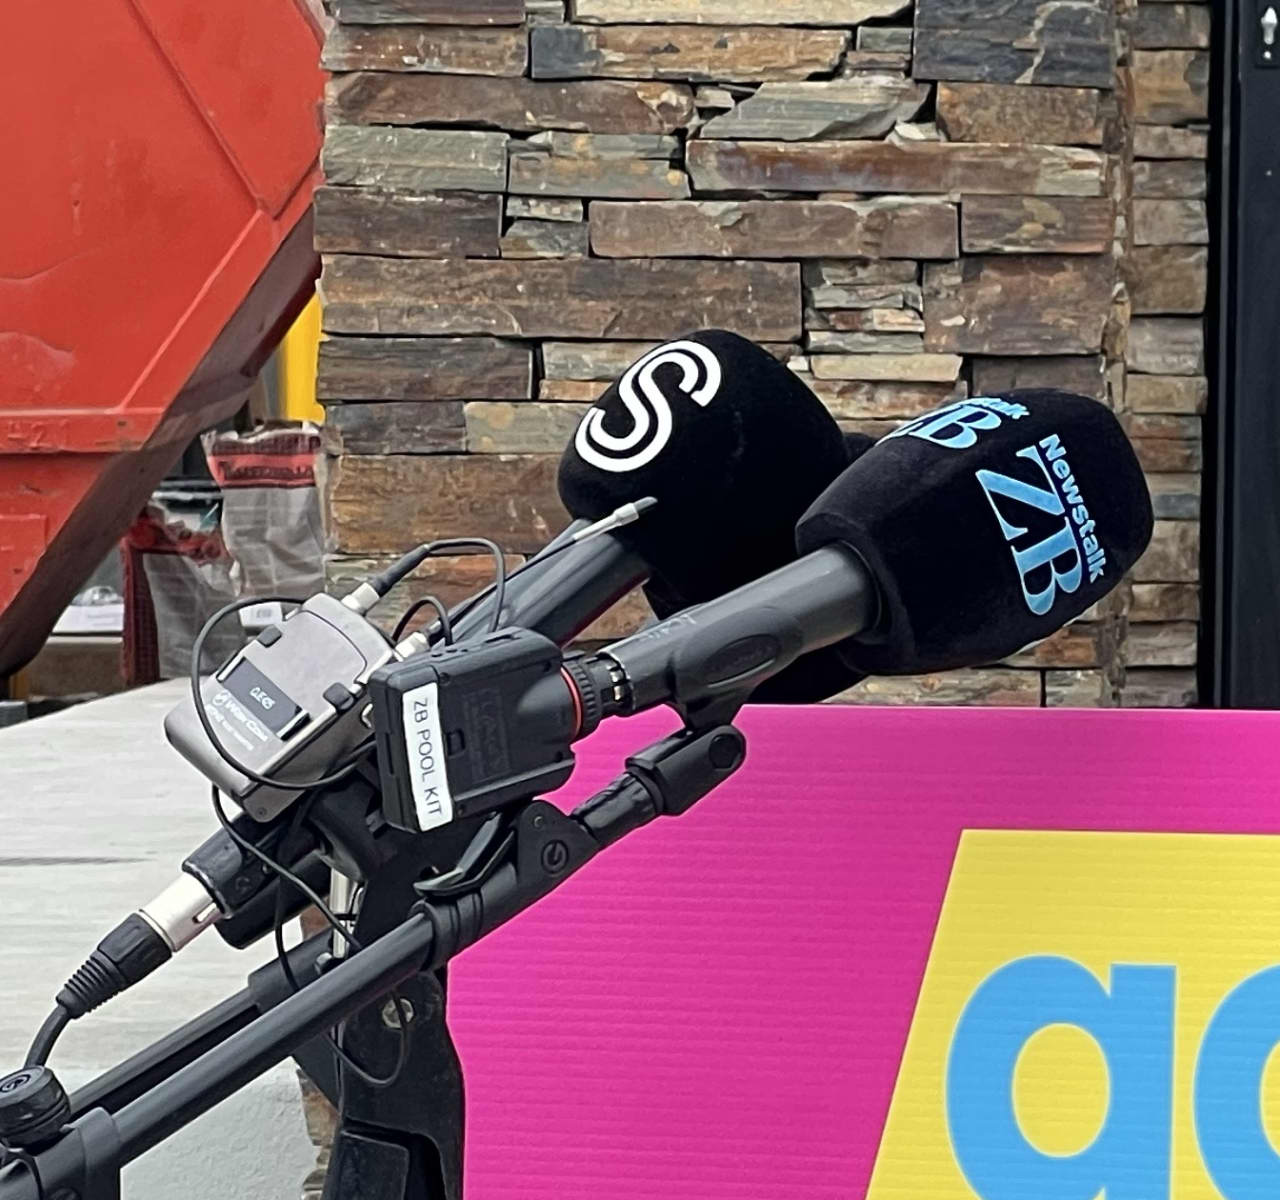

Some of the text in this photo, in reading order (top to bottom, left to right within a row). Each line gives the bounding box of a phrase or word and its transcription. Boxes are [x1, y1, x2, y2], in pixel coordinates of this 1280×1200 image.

[975, 445, 1082, 616] ZB
[1039, 433, 1107, 584] Newstalk
[412, 698, 442, 815] ZB POOL KIT
